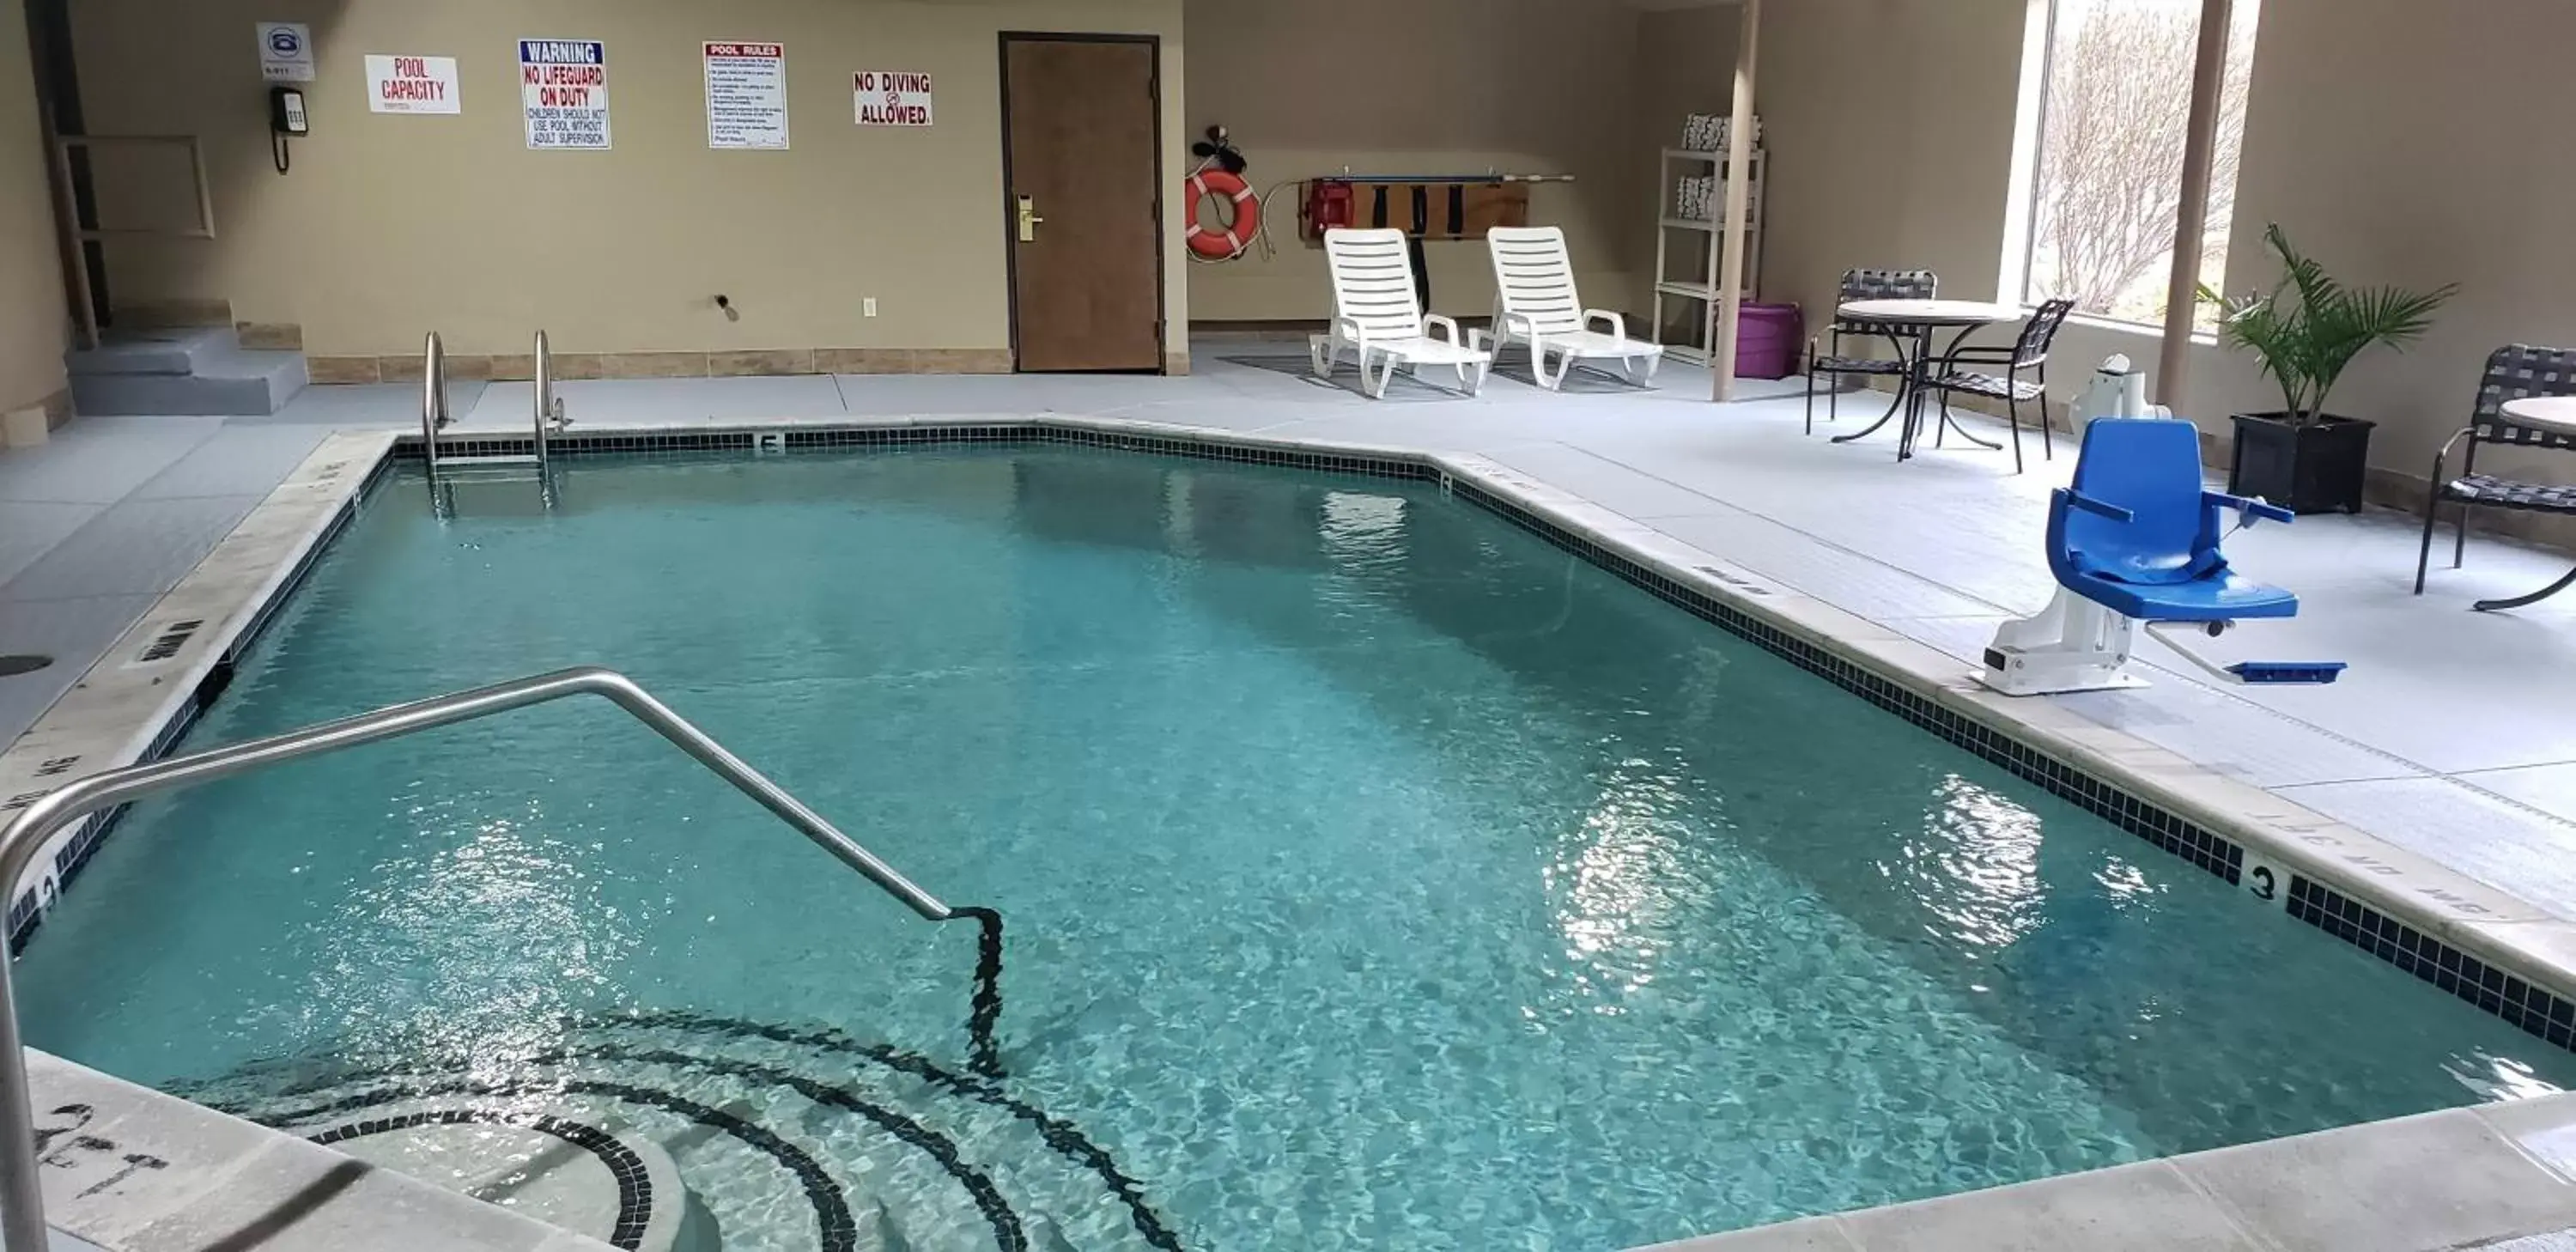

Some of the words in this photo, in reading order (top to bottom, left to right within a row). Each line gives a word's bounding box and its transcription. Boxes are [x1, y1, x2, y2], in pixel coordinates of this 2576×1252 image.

[526, 41, 596, 63] WARNING
[711, 45, 738, 55] POOL
[743, 46, 776, 56] RULES
[394, 58, 429, 78] POOL
[525, 65, 540, 84] NO
[544, 65, 603, 85] LIFEGUARD
[381, 80, 446, 100] CAPACITY
[854, 73, 875, 91] NO
[882, 74, 930, 93] DIVING
[540, 87, 556, 106] ON
[559, 87, 589, 107] DUTY
[528, 107, 561, 119] CHILDREN
[563, 108, 590, 120] SHOULD
[592, 109, 605, 120] NOT
[533, 119, 548, 131] USE
[550, 119, 569, 131] POOL
[571, 120, 603, 132] WITHOUT
[533, 132, 556, 144] ADULT
[559, 133, 605, 145] SUPERVISION
[2250, 865, 2275, 901] 3
